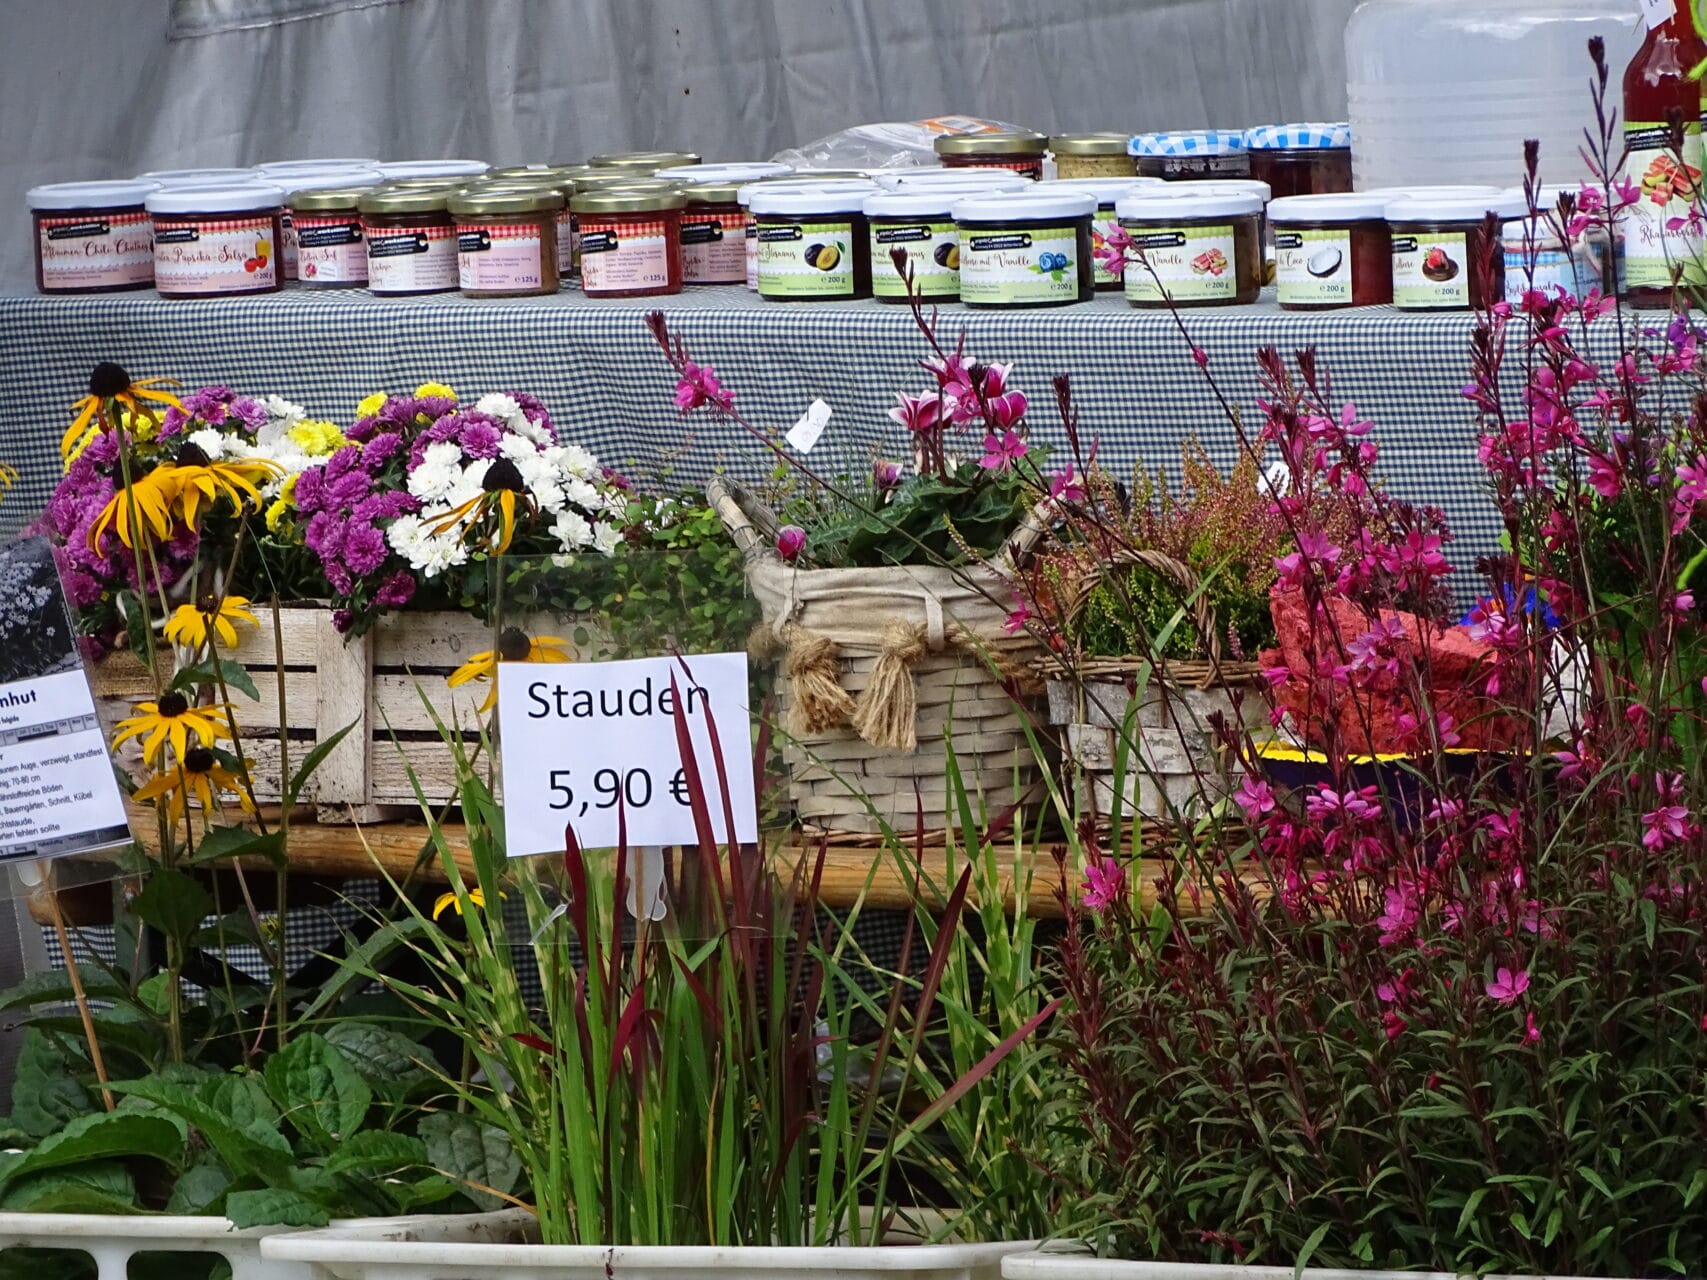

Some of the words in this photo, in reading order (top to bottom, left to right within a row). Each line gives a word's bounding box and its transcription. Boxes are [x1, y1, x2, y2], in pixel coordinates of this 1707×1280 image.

[993, 252, 1032, 268] Vanille
[1147, 250, 1184, 266] Vanille
[1225, 282, 1229, 290] g
[528, 677, 710, 719] Stauden
[74, 748, 103, 760] standfest
[41, 784, 64, 794] Böden
[548, 767, 652, 818] 5,90
[73, 791, 94, 802] Kübel
